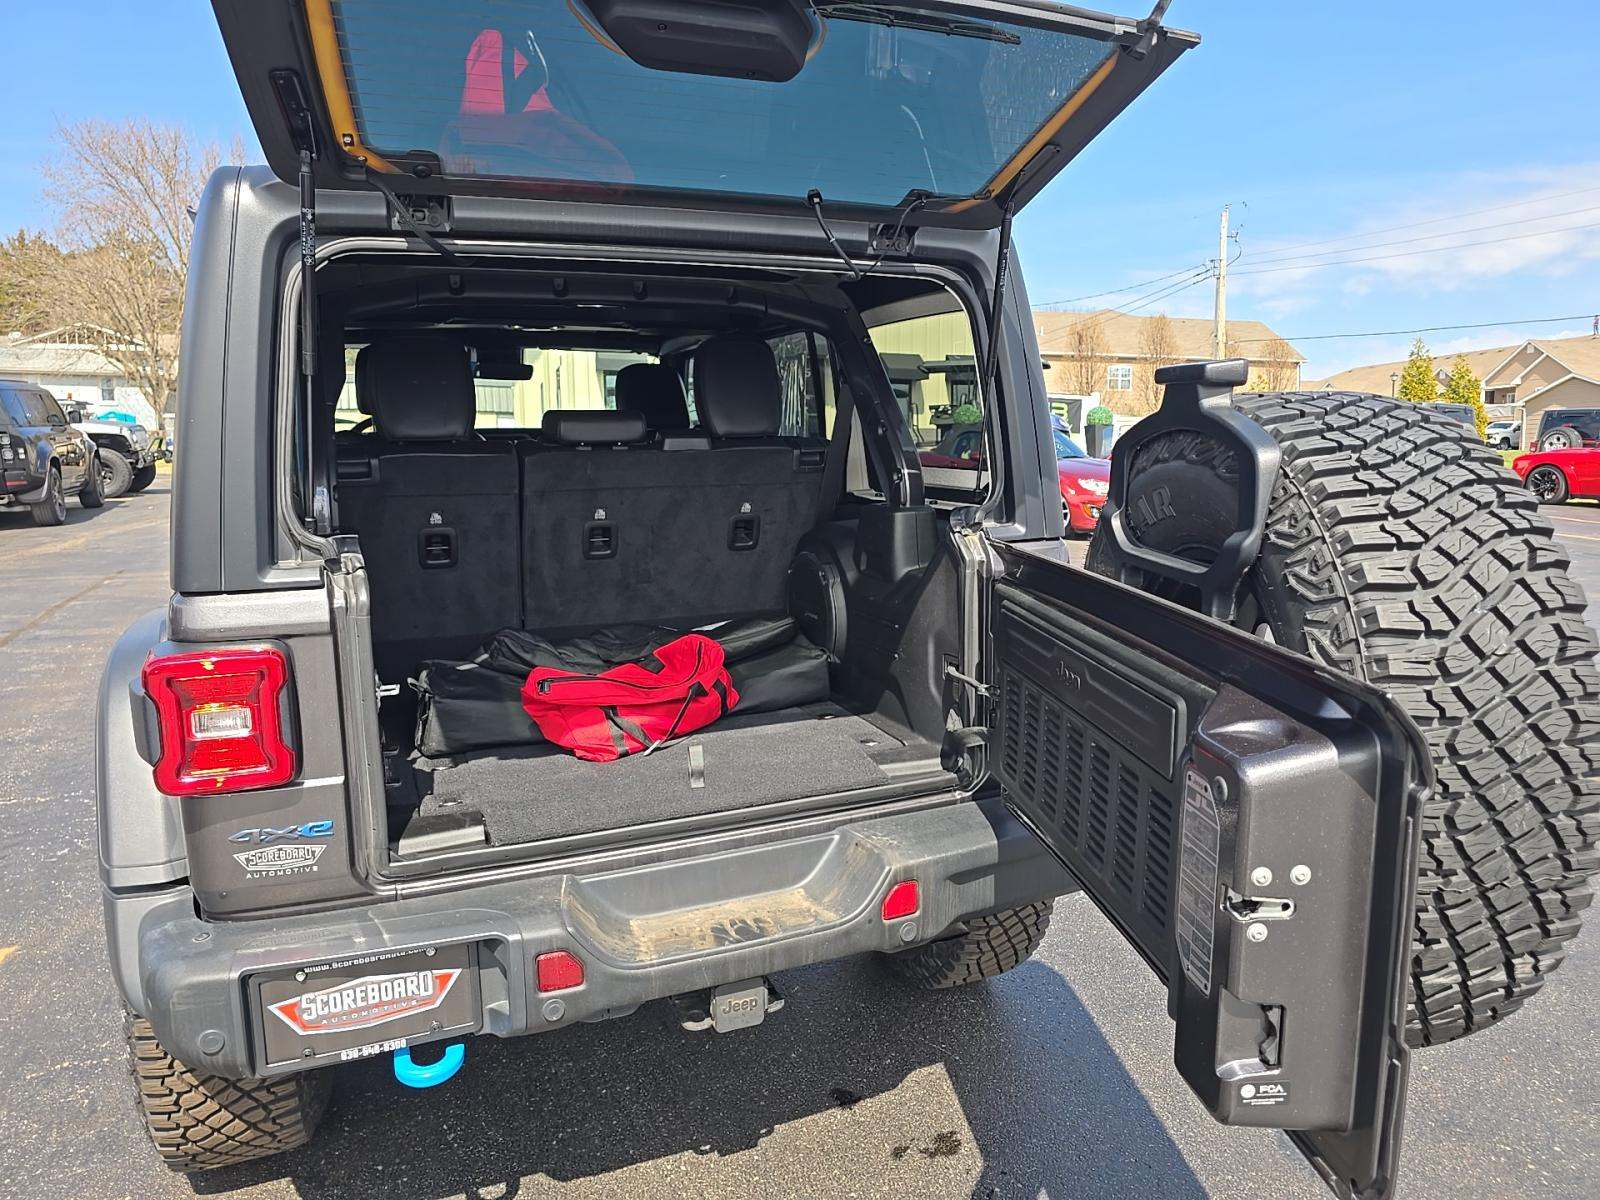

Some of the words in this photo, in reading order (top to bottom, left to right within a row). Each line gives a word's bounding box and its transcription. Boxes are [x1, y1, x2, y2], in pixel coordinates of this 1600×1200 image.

[248, 846, 314, 865] SCOREBOARD
[246, 865, 319, 879] AUTOMOTIVE
[301, 970, 433, 1020] SCOREBOARD
[321, 999, 418, 1025] AUTOMOTIVE
[722, 997, 758, 1015] Jeep
